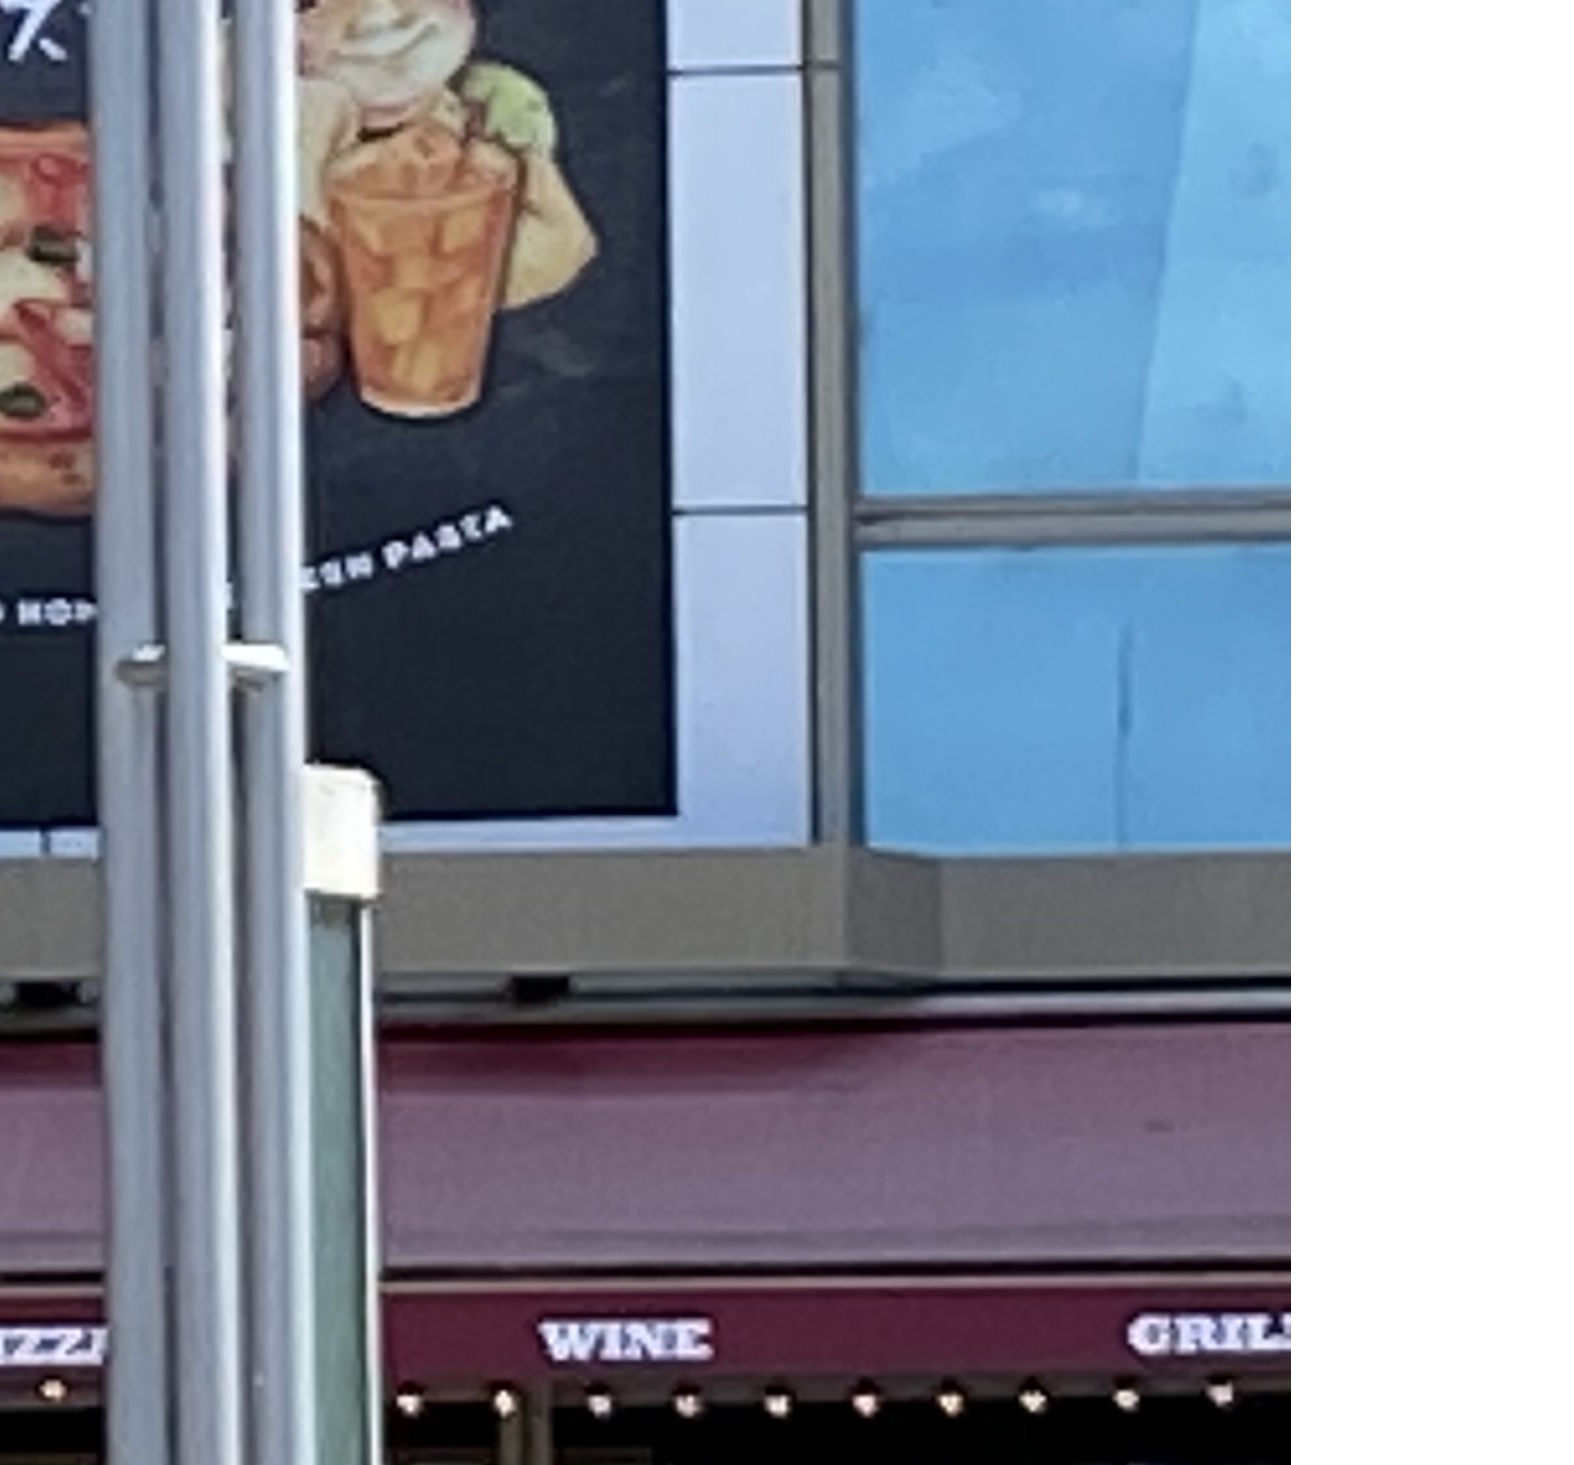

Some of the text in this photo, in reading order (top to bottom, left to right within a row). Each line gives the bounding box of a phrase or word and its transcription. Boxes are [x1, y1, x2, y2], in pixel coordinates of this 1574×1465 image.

[381, 505, 513, 569] PASTA
[537, 1318, 714, 1361] WINE
[1127, 1311, 1291, 1355] GRIL
